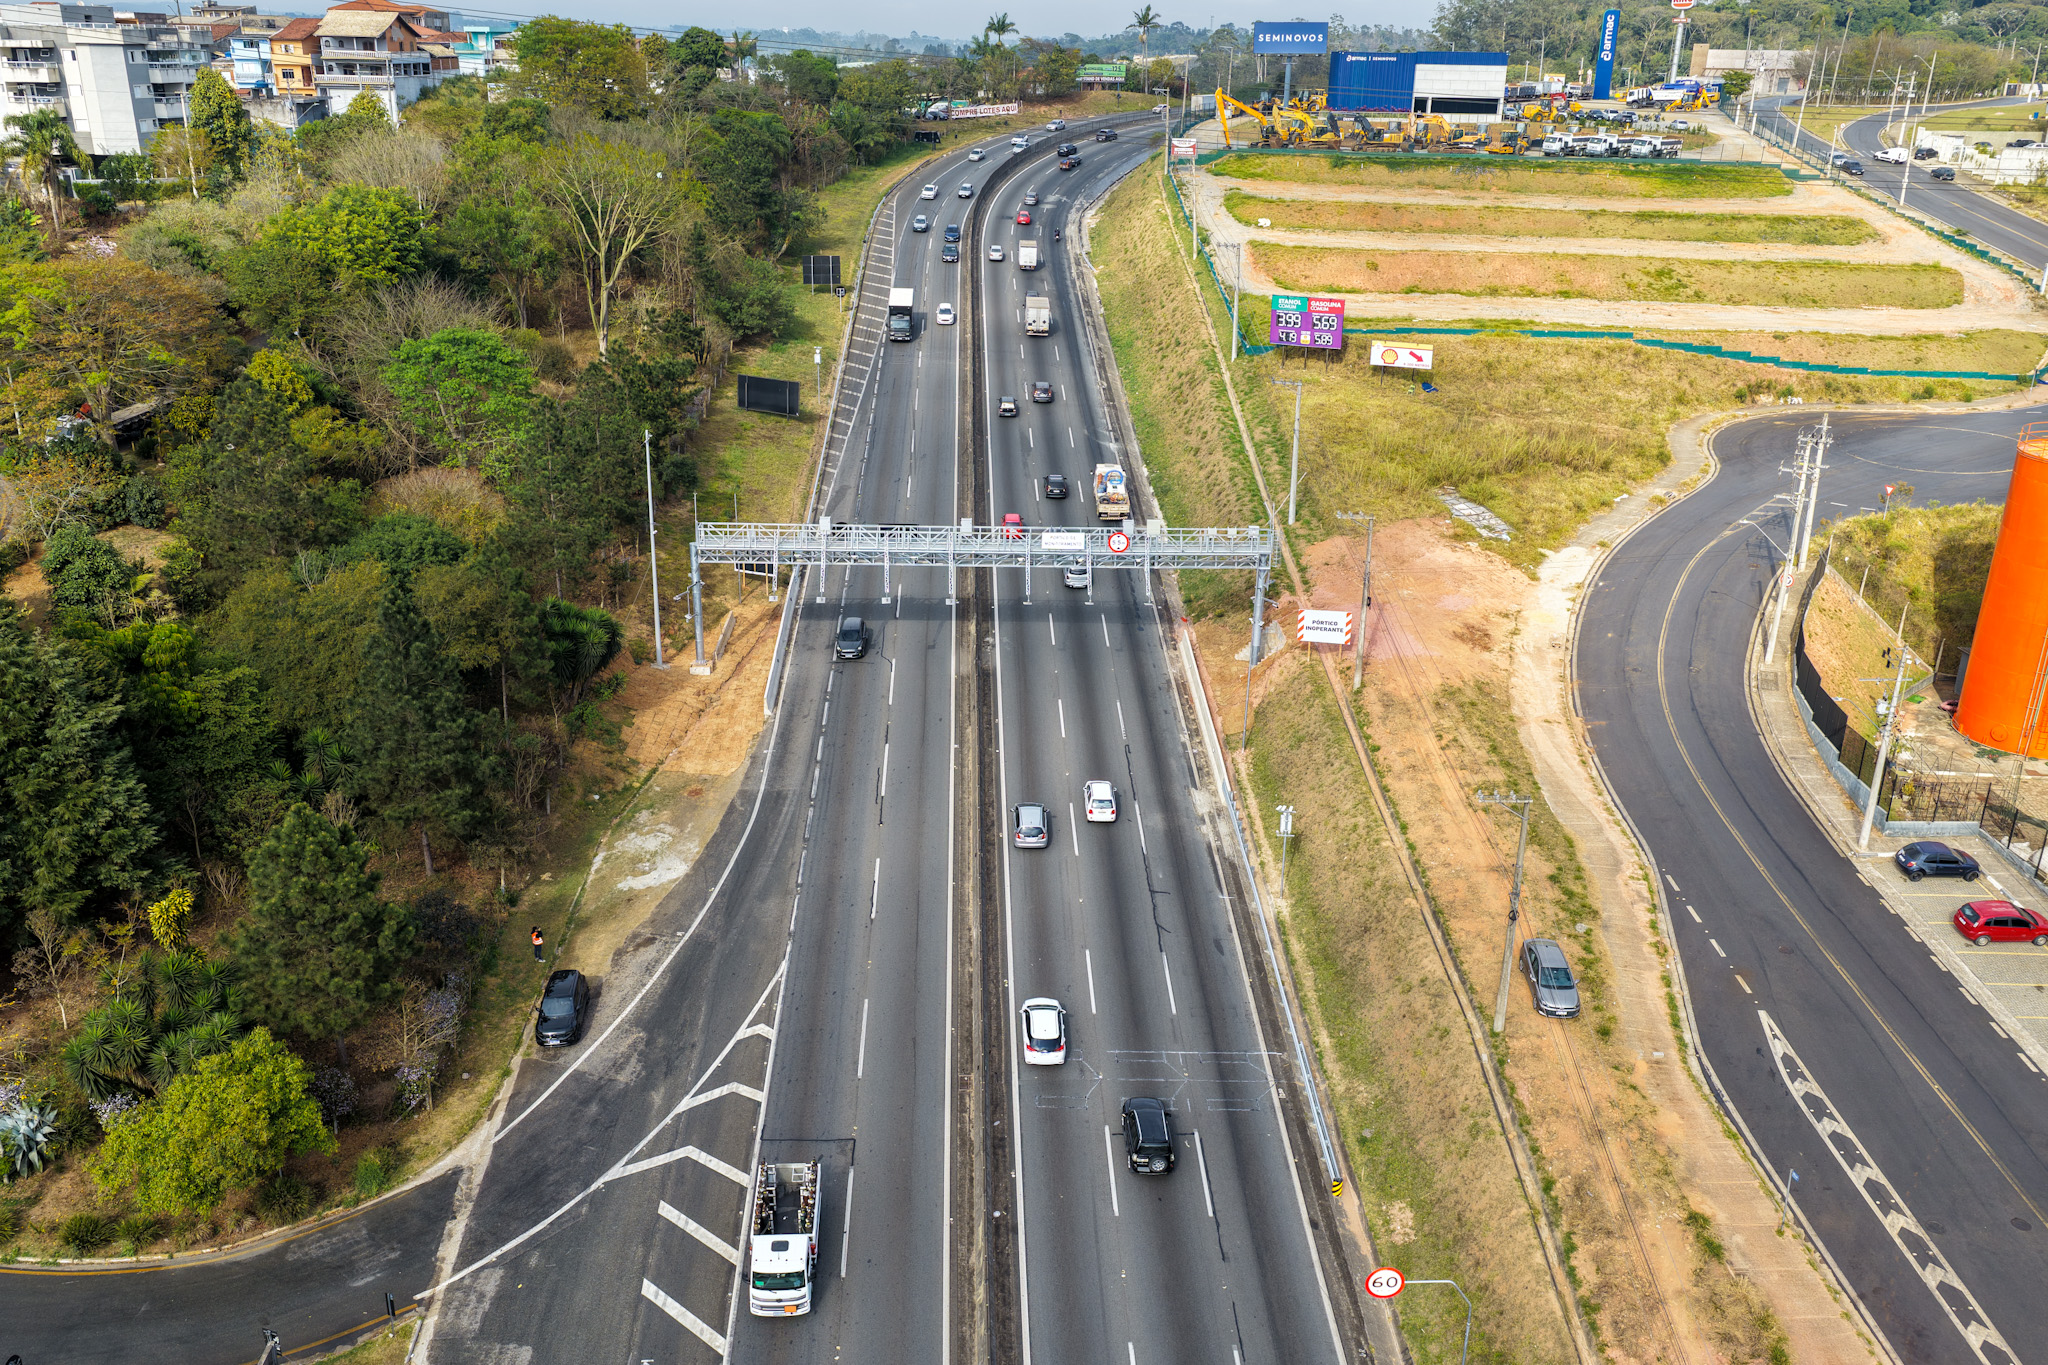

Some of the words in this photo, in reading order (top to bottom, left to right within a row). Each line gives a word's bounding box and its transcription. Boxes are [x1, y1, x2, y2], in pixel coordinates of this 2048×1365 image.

[1258, 34, 1324, 42] SEMINOVOS
[1604, 14, 1615, 50] armac
[1278, 313, 1301, 328] 3.99
[1313, 316, 1337, 330] 5.69
[1372, 1277, 1398, 1288] 60
